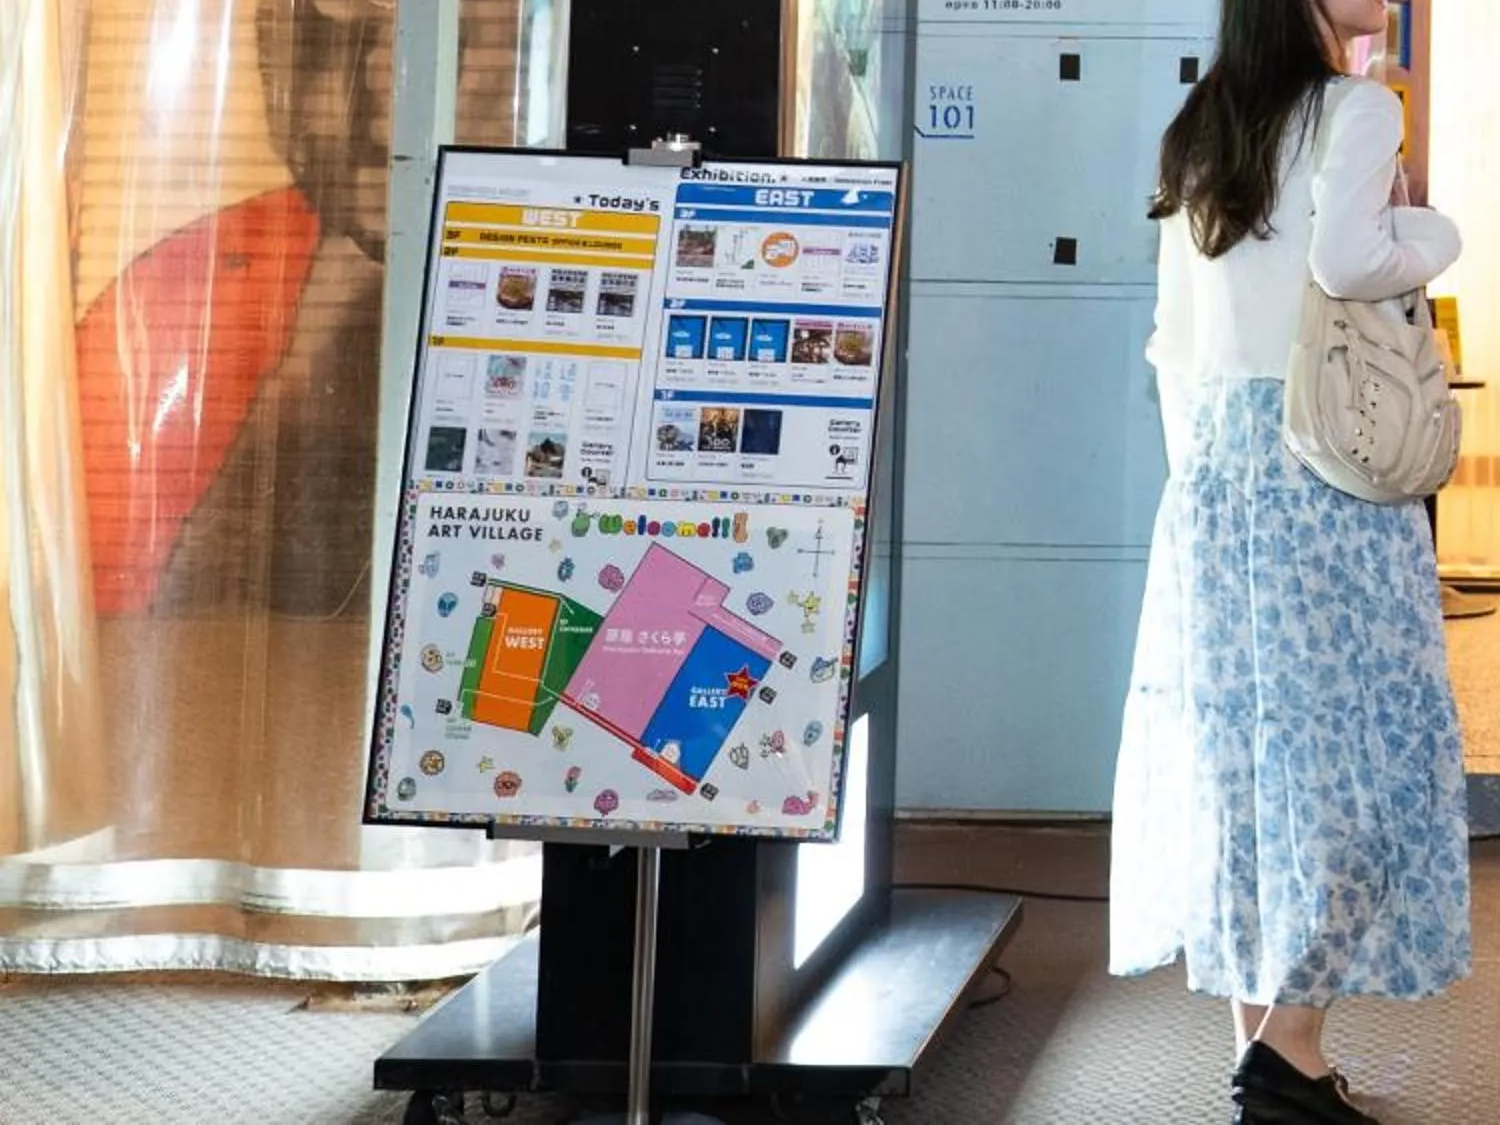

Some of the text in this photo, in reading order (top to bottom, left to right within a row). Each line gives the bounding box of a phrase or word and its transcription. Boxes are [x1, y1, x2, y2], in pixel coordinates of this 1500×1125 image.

[929, 85, 974, 101] SPACE
[929, 105, 975, 130] 101
[588, 194, 661, 212] Today's
[754, 189, 815, 208] EAST
[521, 208, 585, 228] WEST
[429, 506, 531, 523] HARAJUKU
[427, 524, 543, 542] ART VILLAGE
[504, 636, 545, 650] WEST
[688, 695, 726, 709] EAST
